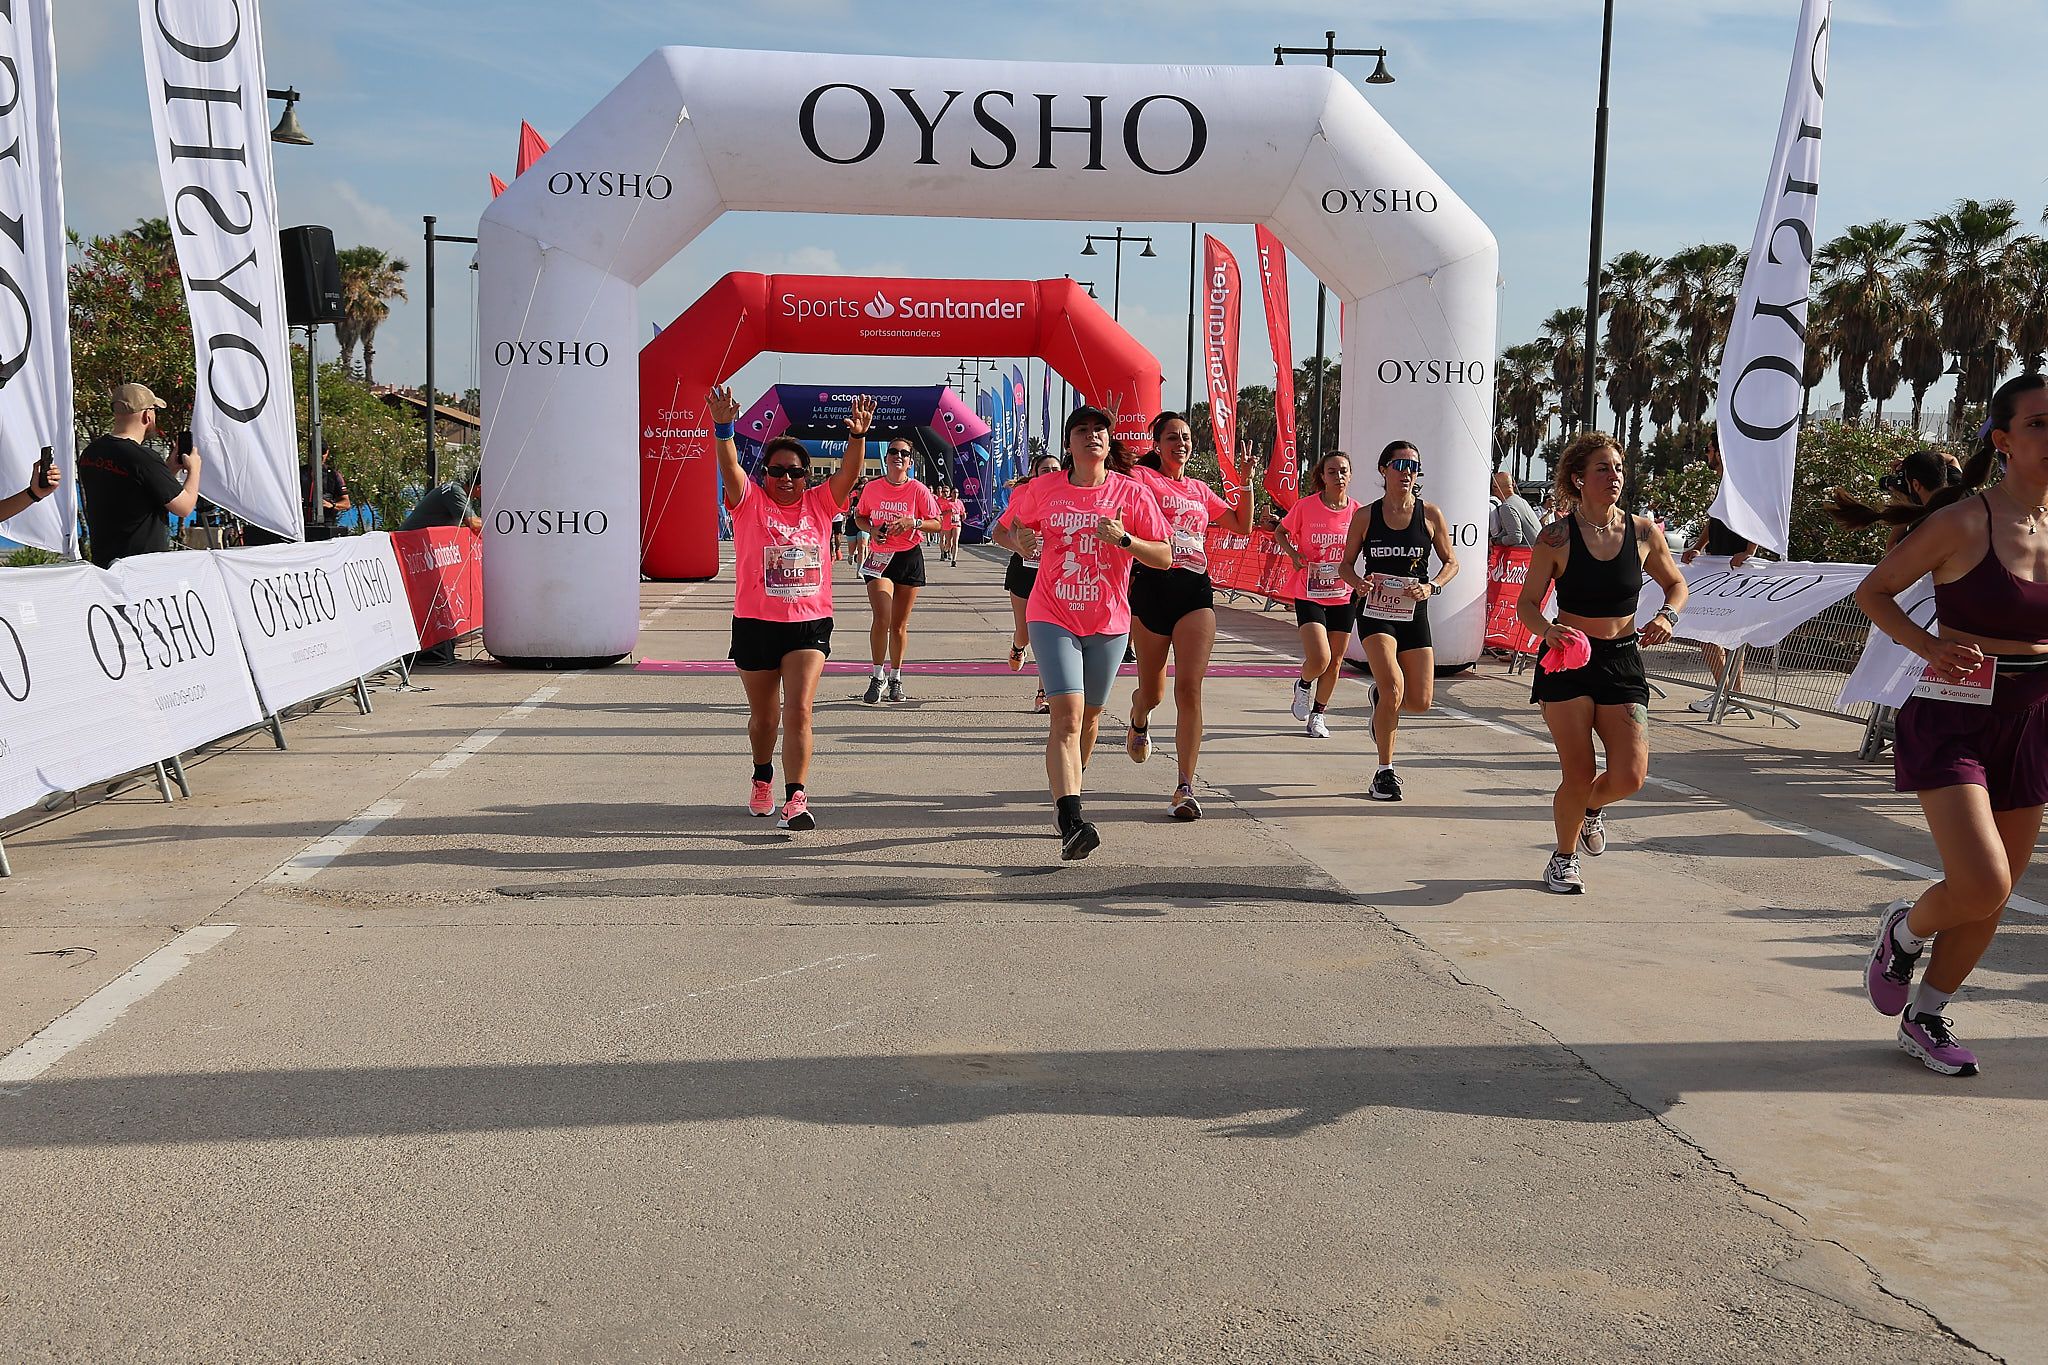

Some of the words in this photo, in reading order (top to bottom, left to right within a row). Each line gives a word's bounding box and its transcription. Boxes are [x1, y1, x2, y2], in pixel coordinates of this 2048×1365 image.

[798, 83, 1208, 175] OYSHO
[547, 171, 673, 201] OYSHO
[1321, 188, 1438, 214] OYSHO
[782, 293, 859, 323] Sports
[899, 297, 1025, 319] Santander
[859, 328, 941, 338] sportssantander.es
[494, 340, 609, 368] OYSHO
[1377, 359, 1485, 385] OYSHO
[658, 409, 694, 422] Sports
[876, 407, 906, 415] CORRER
[655, 428, 709, 438] Santander
[1112, 430, 1154, 440] antand
[880, 501, 908, 512] SOMOS
[494, 510, 608, 535] OYSHO
[1050, 512, 1100, 527] CARRER
[1080, 533, 1098, 554] DE
[1176, 546, 1193, 554] 016
[783, 568, 805, 577] 016
[344, 557, 392, 612] OYSHO
[1055, 584, 1099, 602] MUJER
[250, 567, 336, 638] OYSHO
[1381, 595, 1401, 604] 016
[87, 589, 215, 680] OYSHO
[1947, 690, 1981, 699] Santander
